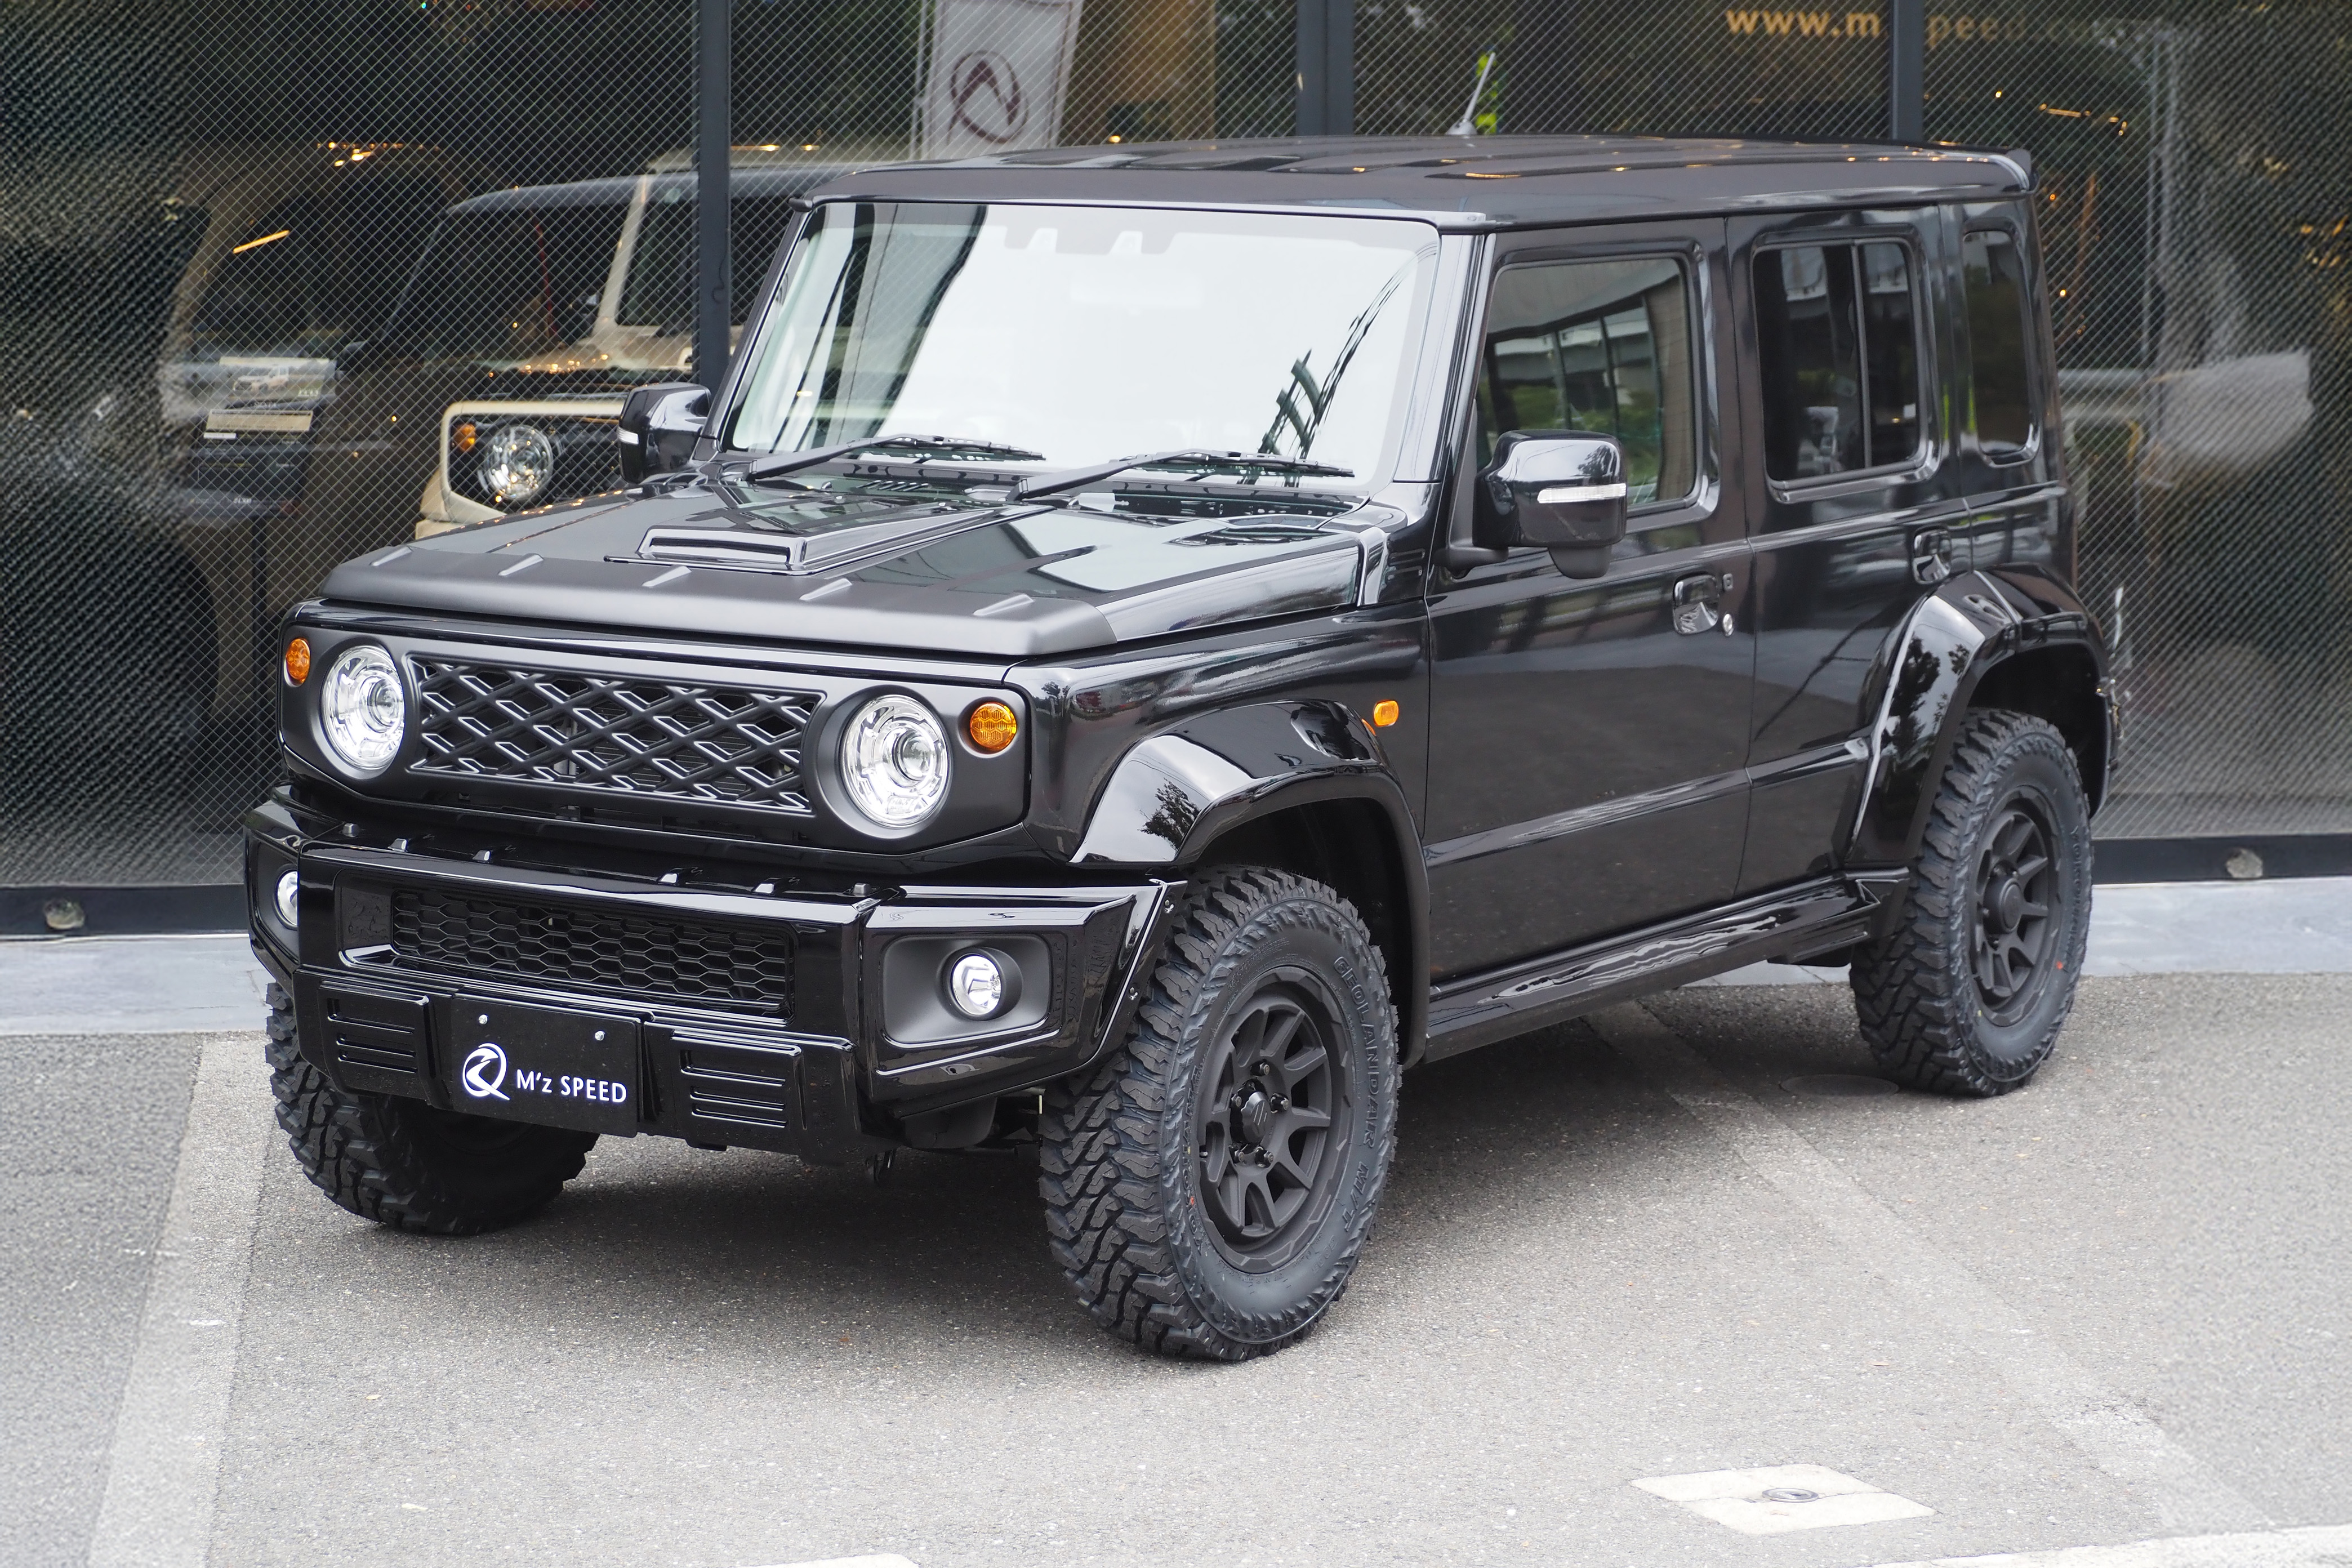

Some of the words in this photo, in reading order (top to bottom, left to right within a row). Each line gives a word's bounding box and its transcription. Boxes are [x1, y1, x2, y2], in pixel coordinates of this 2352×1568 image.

[516, 1068, 553, 1094] M'z
[560, 1075, 627, 1103] SPEED
[1334, 956, 1380, 1148] GEOLANDAR
[1342, 1161, 1369, 1232] M/T
